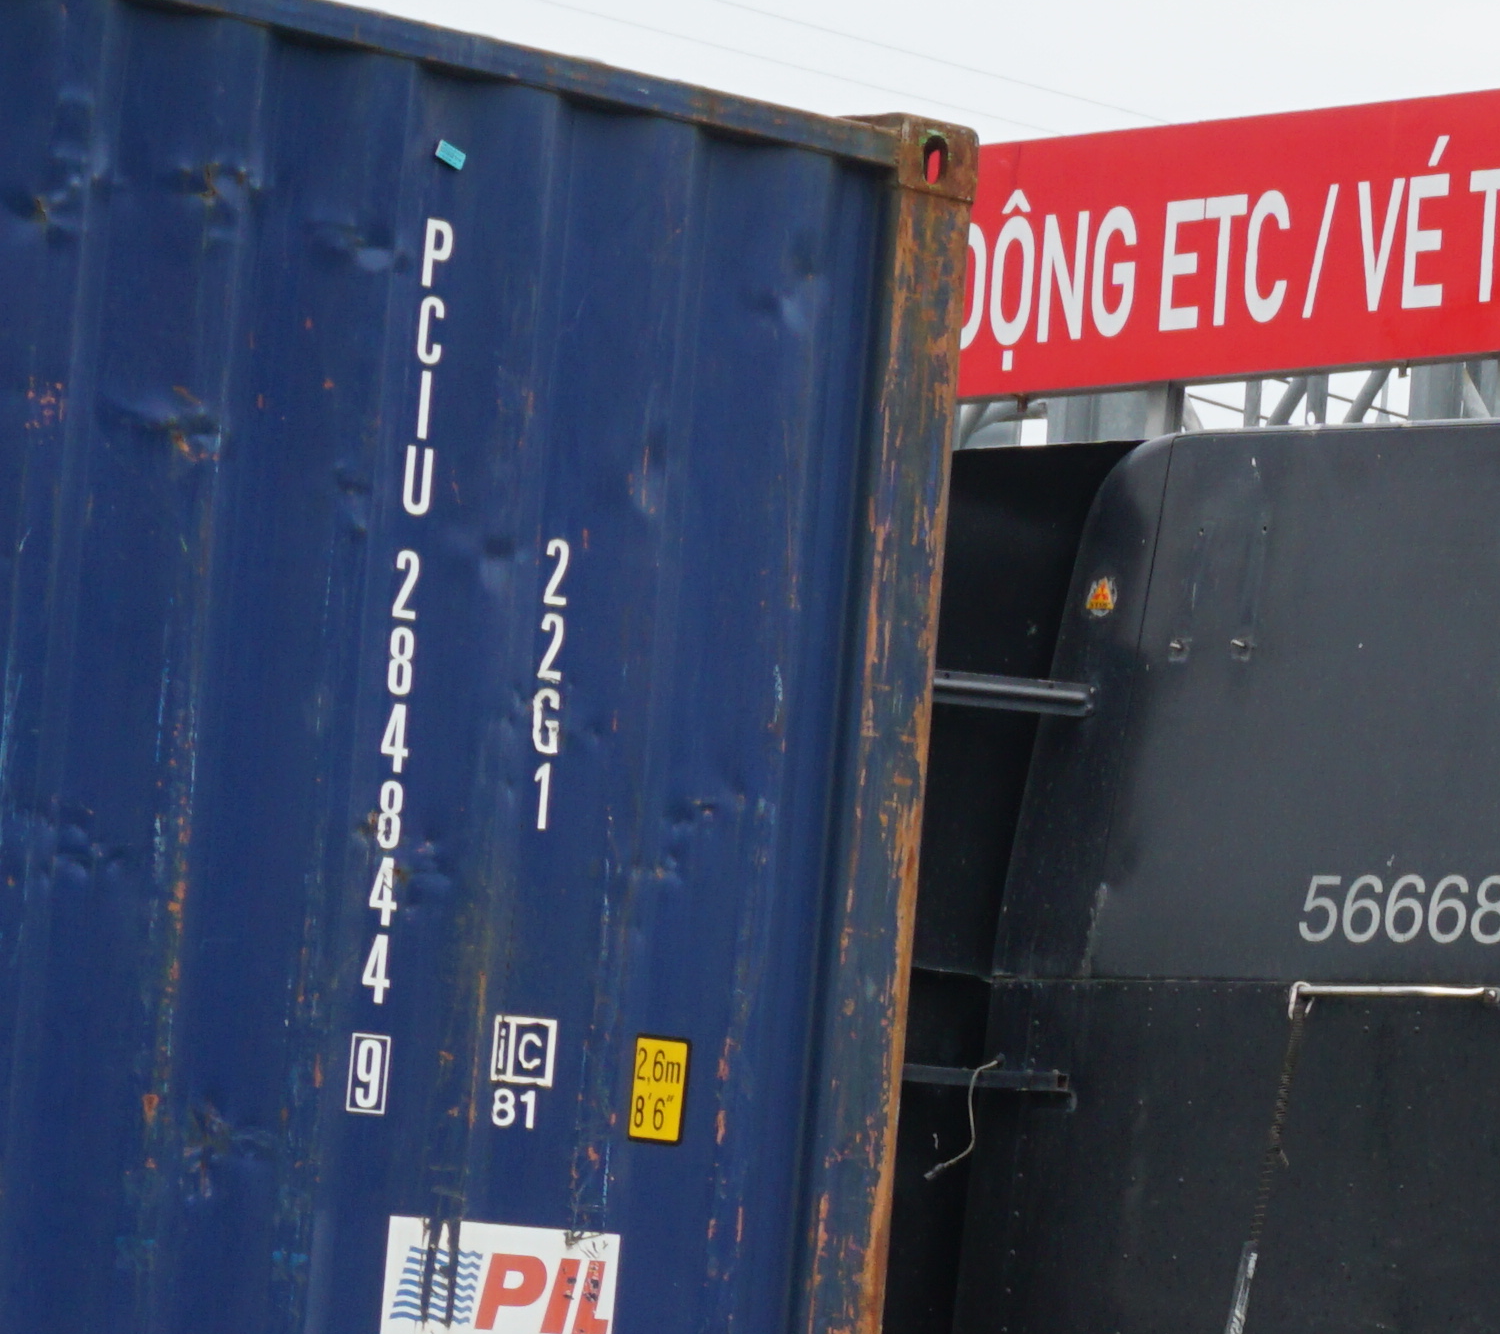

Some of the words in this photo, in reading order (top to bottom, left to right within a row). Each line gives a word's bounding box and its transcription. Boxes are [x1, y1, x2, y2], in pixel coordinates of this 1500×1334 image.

[1158, 189, 1291, 331] ETC
[1357, 134, 1449, 313] VÉ
[401, 217, 453, 516] PCIU
[361, 549, 420, 1005] 284844
[531, 539, 570, 830] 22G1
[355, 1038, 382, 1107] 9
[491, 1088, 537, 1129] 81
